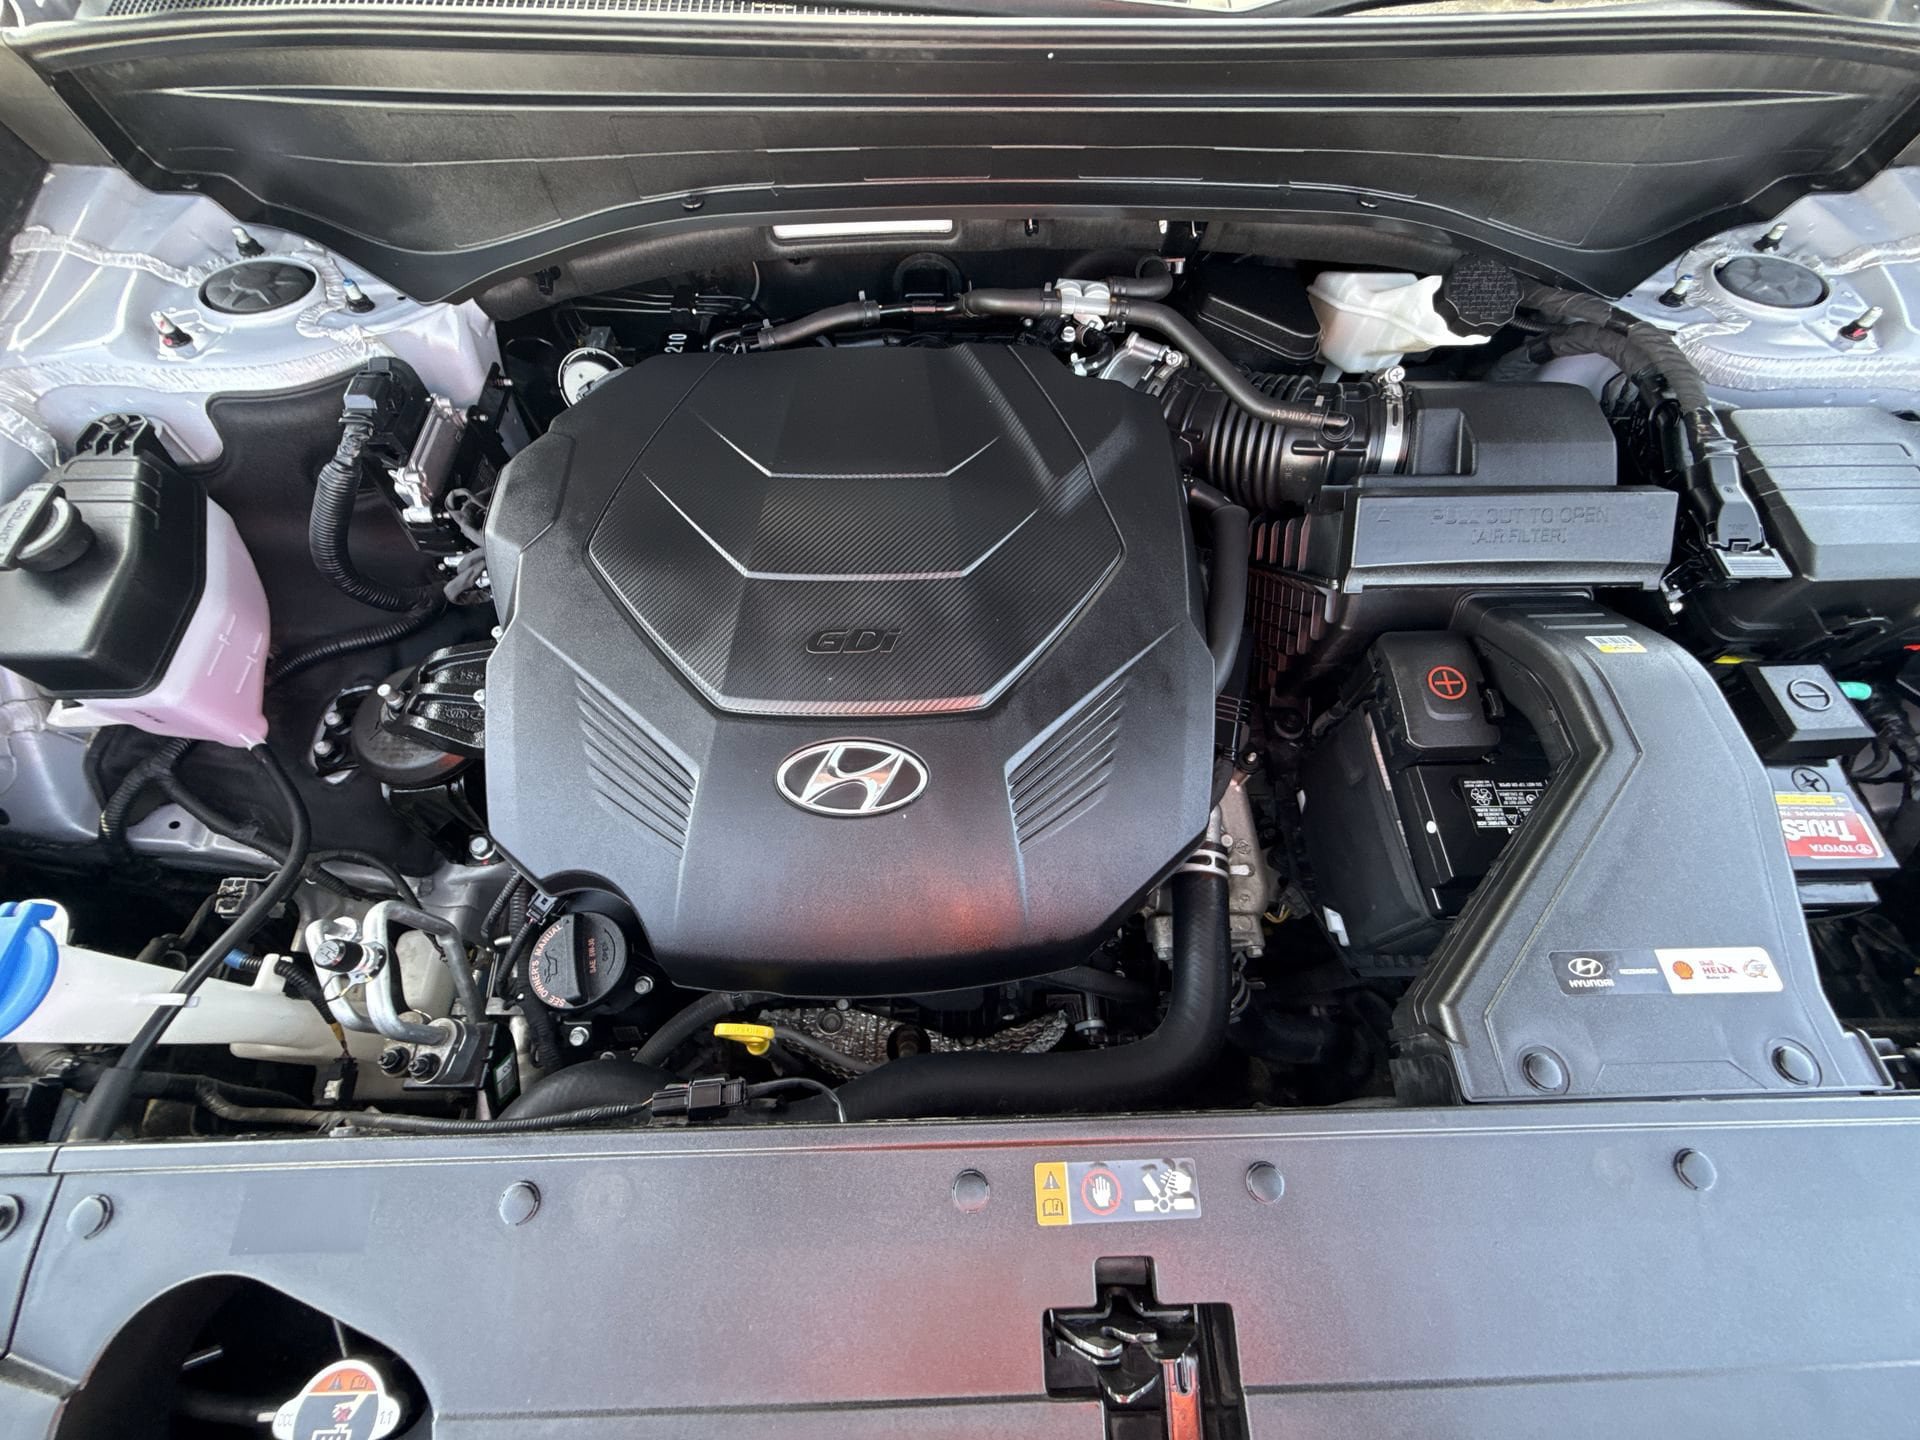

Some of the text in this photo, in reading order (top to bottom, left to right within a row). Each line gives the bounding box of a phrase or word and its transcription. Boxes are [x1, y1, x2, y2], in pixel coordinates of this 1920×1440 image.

[1430, 505, 1609, 525] PULL OUT TO OPEN
[1808, 844, 1857, 853] TOYOTA
[531, 924, 566, 1007] SEE OWNER'S MANUAL
[1702, 966, 1738, 975] HELIX
[1568, 978, 1616, 988] HYUNDAI
